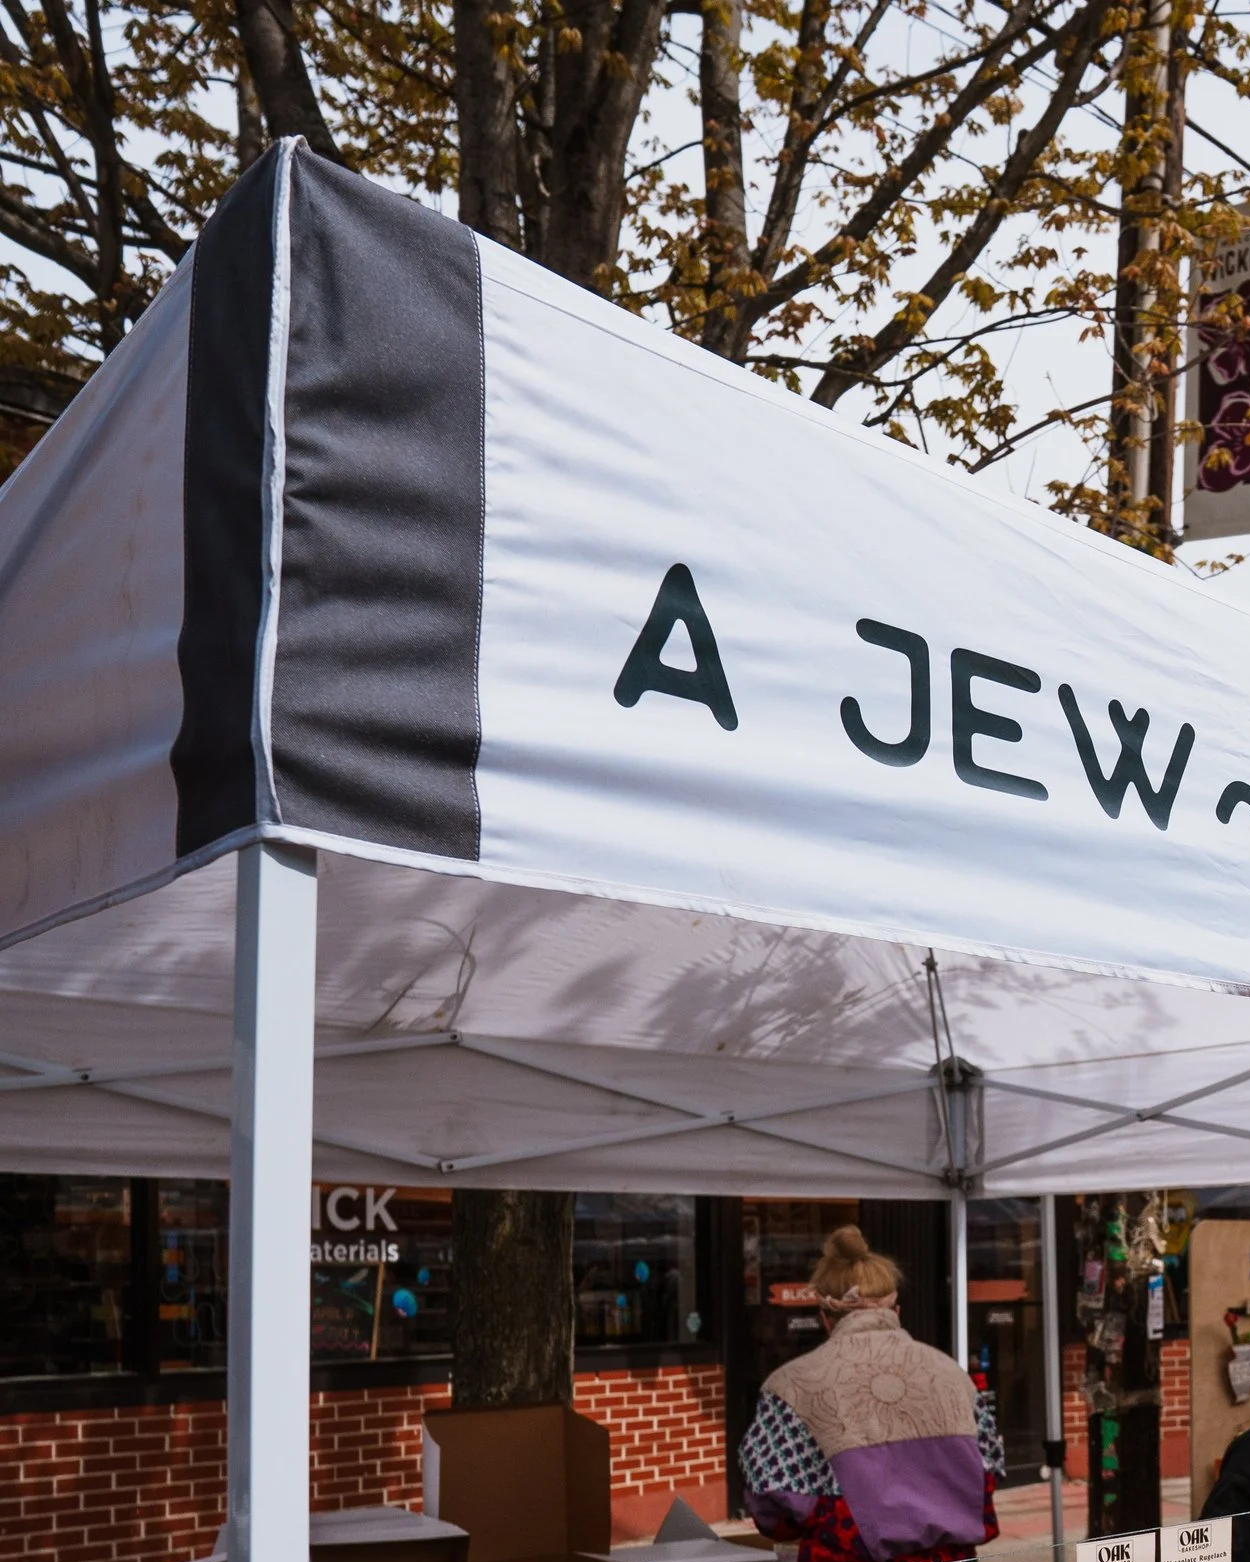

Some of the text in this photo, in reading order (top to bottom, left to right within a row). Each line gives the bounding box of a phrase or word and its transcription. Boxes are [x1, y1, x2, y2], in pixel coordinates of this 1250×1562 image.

[614, 563, 738, 731] A
[312, 1185, 398, 1231] ICK
[311, 1239, 399, 1262] aterials
[1180, 1527, 1209, 1546] OAK
[1098, 1544, 1130, 1562] OAK
[1182, 1543, 1209, 1553] BAKESHOP
[1199, 1551, 1227, 1562] Rugelach
